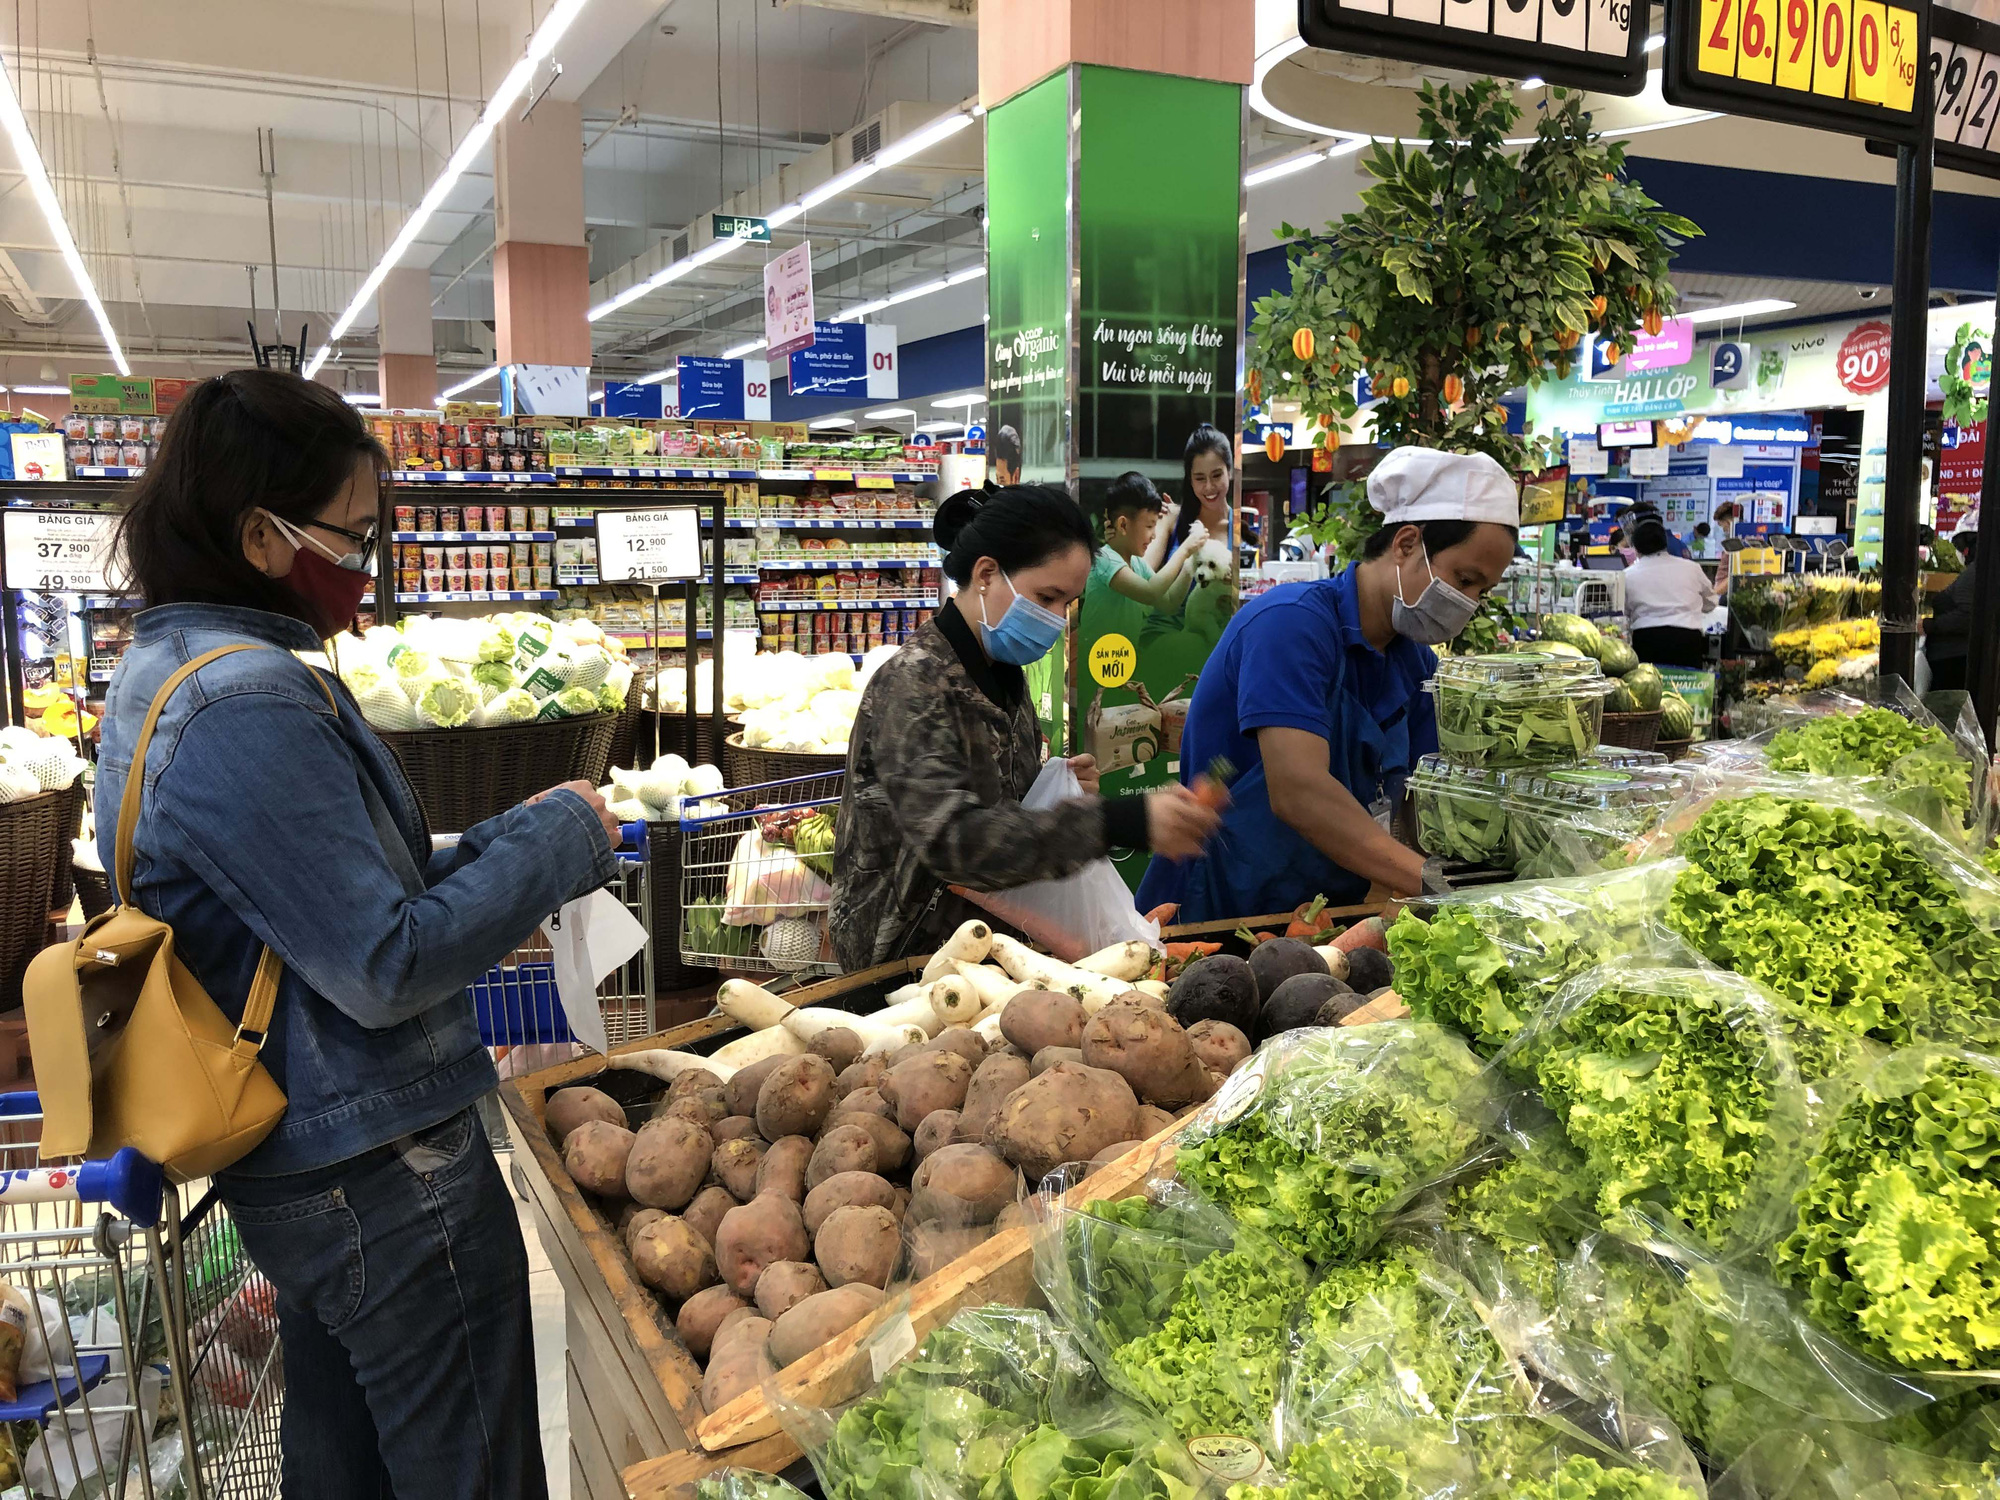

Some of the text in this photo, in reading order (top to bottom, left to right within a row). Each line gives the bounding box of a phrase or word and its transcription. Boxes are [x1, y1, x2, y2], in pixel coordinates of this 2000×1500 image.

[1707, 0, 1880, 77] 26.900
[720, 222, 733, 232] EXIT
[1093, 318, 1223, 355] Ăn ngon sống khỏe
[1791, 337, 1825, 352] vivo
[1013, 329, 1060, 363] Organic
[1844, 345, 1858, 356] Tiết
[1859, 340, 1878, 351] kiệm
[873, 352, 893, 371] 01
[1722, 350, 1736, 373] 2
[1102, 361, 1212, 394] Vui vẻ mỗi ngày
[747, 382, 767, 398] 02
[1613, 377, 1653, 404] HAI
[1655, 372, 1698, 401] LỚP
[664, 404, 680, 418] 03
[971, 430, 981, 440] 7
[1825, 488, 1843, 496] KIM
[38, 513, 95, 525] BẢNG GIÁ
[625, 512, 669, 523] BẢNG GIÁ
[521, 639, 541, 655] Select
[1096, 646, 1130, 659] SẢN PHẨM
[1102, 658, 1125, 679] MỚI
[536, 674, 556, 690] Select
[1109, 722, 1149, 740] Jasmine
[1119, 786, 1134, 796] Sản
[1135, 785, 1157, 796] phẩm
